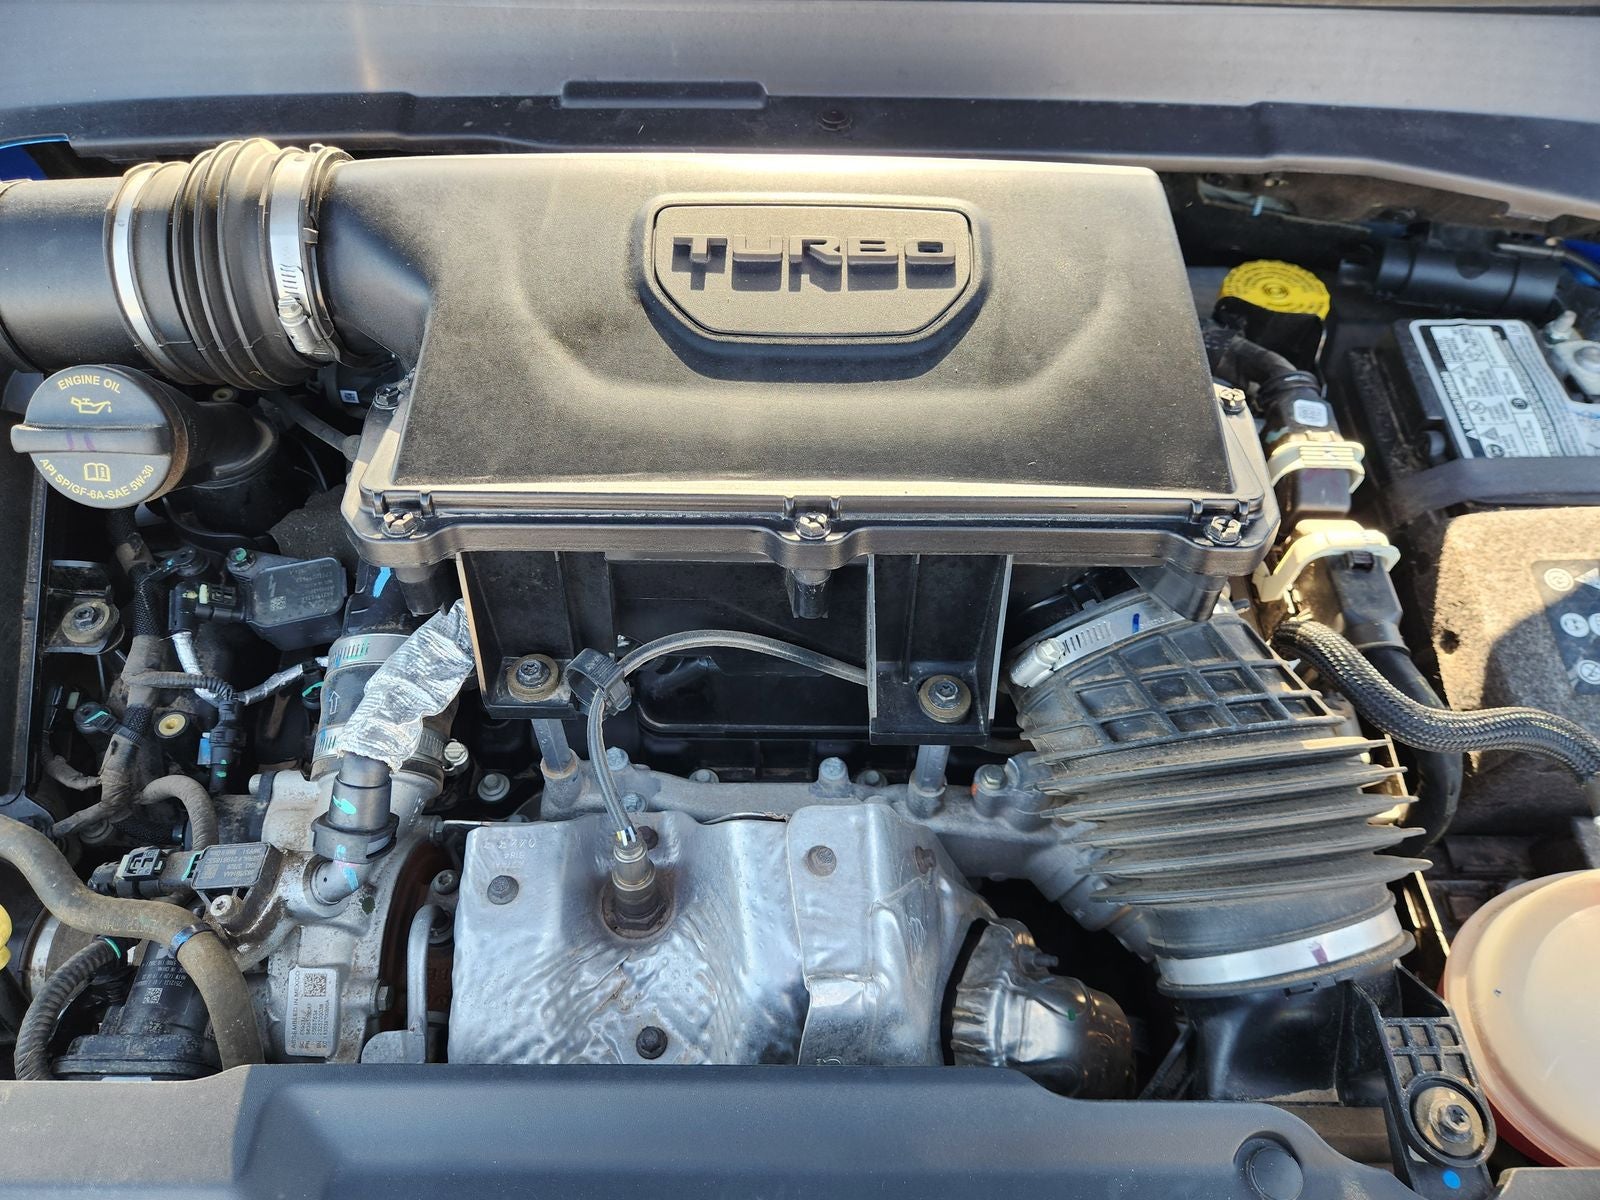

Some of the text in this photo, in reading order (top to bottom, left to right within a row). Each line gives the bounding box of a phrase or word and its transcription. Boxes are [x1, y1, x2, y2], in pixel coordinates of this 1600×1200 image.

[671, 233, 957, 280] TURBO
[58, 375, 121, 393] ENGINE OIL
[39, 459, 155, 499] API SP/GF-6A-SAE 5W-30
